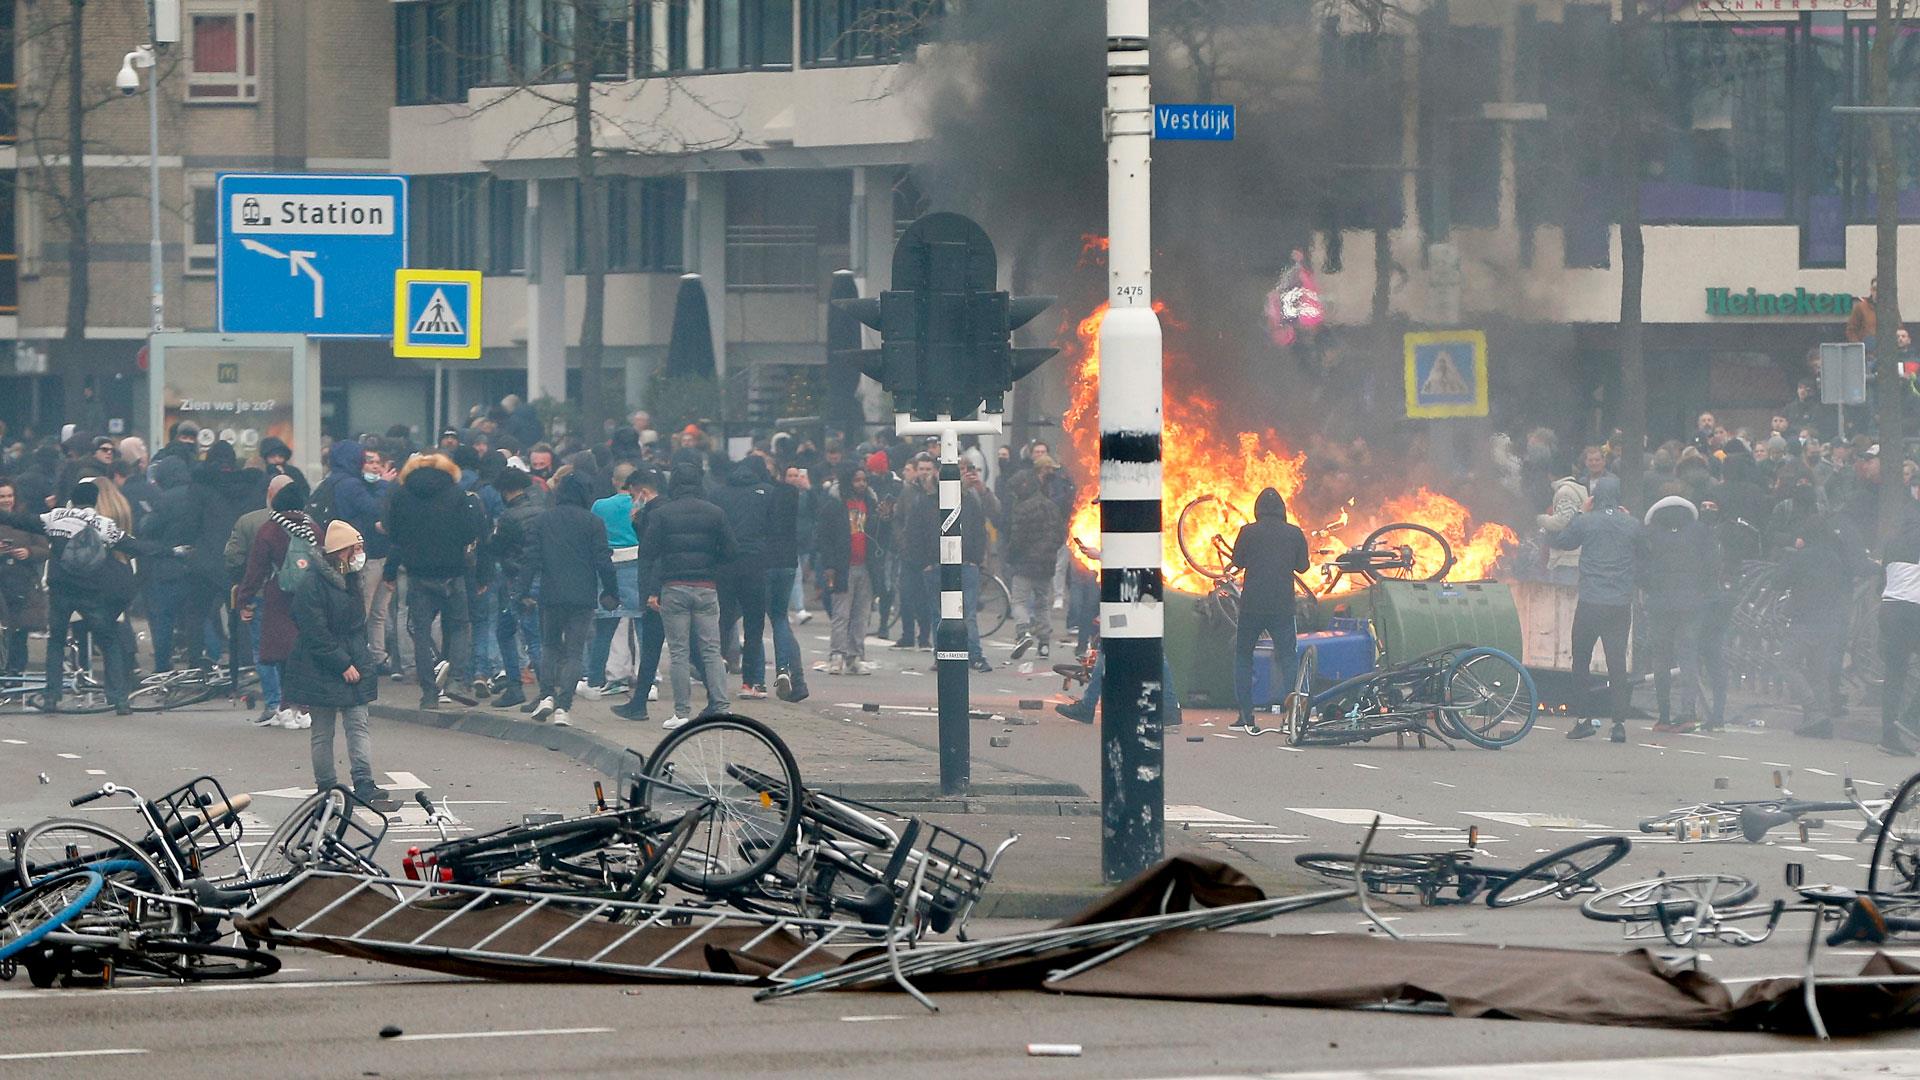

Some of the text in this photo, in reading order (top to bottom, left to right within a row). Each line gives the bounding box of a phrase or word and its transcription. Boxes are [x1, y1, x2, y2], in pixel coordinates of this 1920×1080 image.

[1160, 109, 1229, 135] Vestdijk
[281, 201, 382, 224] Station
[1117, 286, 1143, 295] 2475
[1128, 296, 1133, 304] 1
[1705, 287, 1853, 316] Heineken
[180, 399, 275, 414] Zien we je zo?
